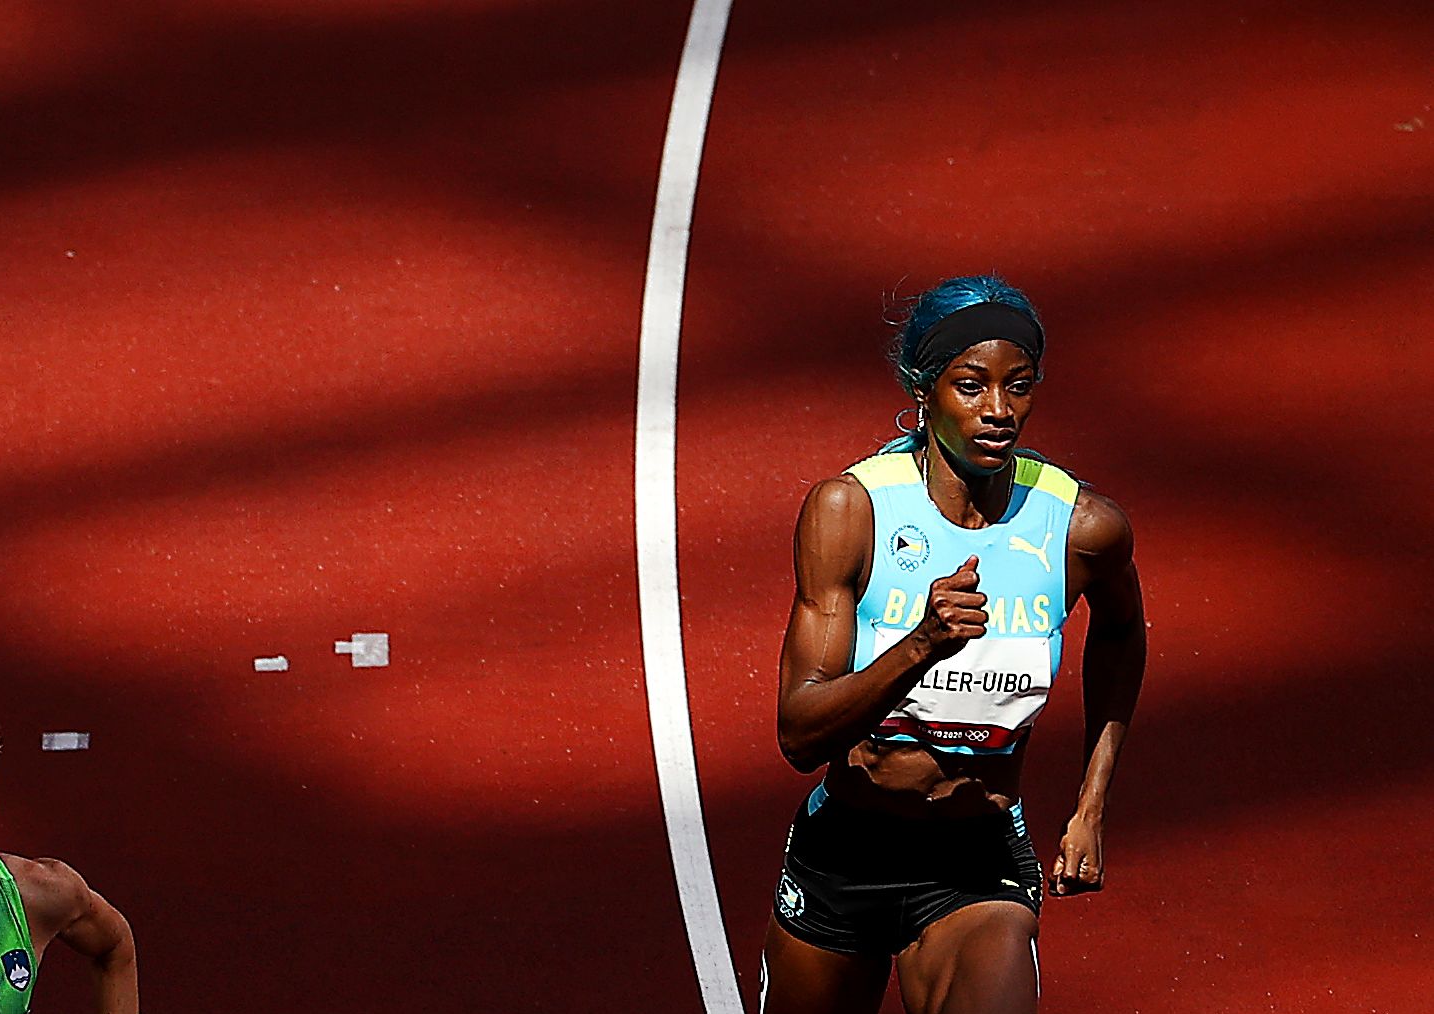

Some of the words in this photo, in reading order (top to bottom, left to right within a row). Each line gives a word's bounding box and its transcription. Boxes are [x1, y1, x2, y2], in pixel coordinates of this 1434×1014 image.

[883, 588, 1050, 634] BAMAS
[919, 669, 1033, 693] LLER-UIBO
[943, 731, 963, 739] 2020
